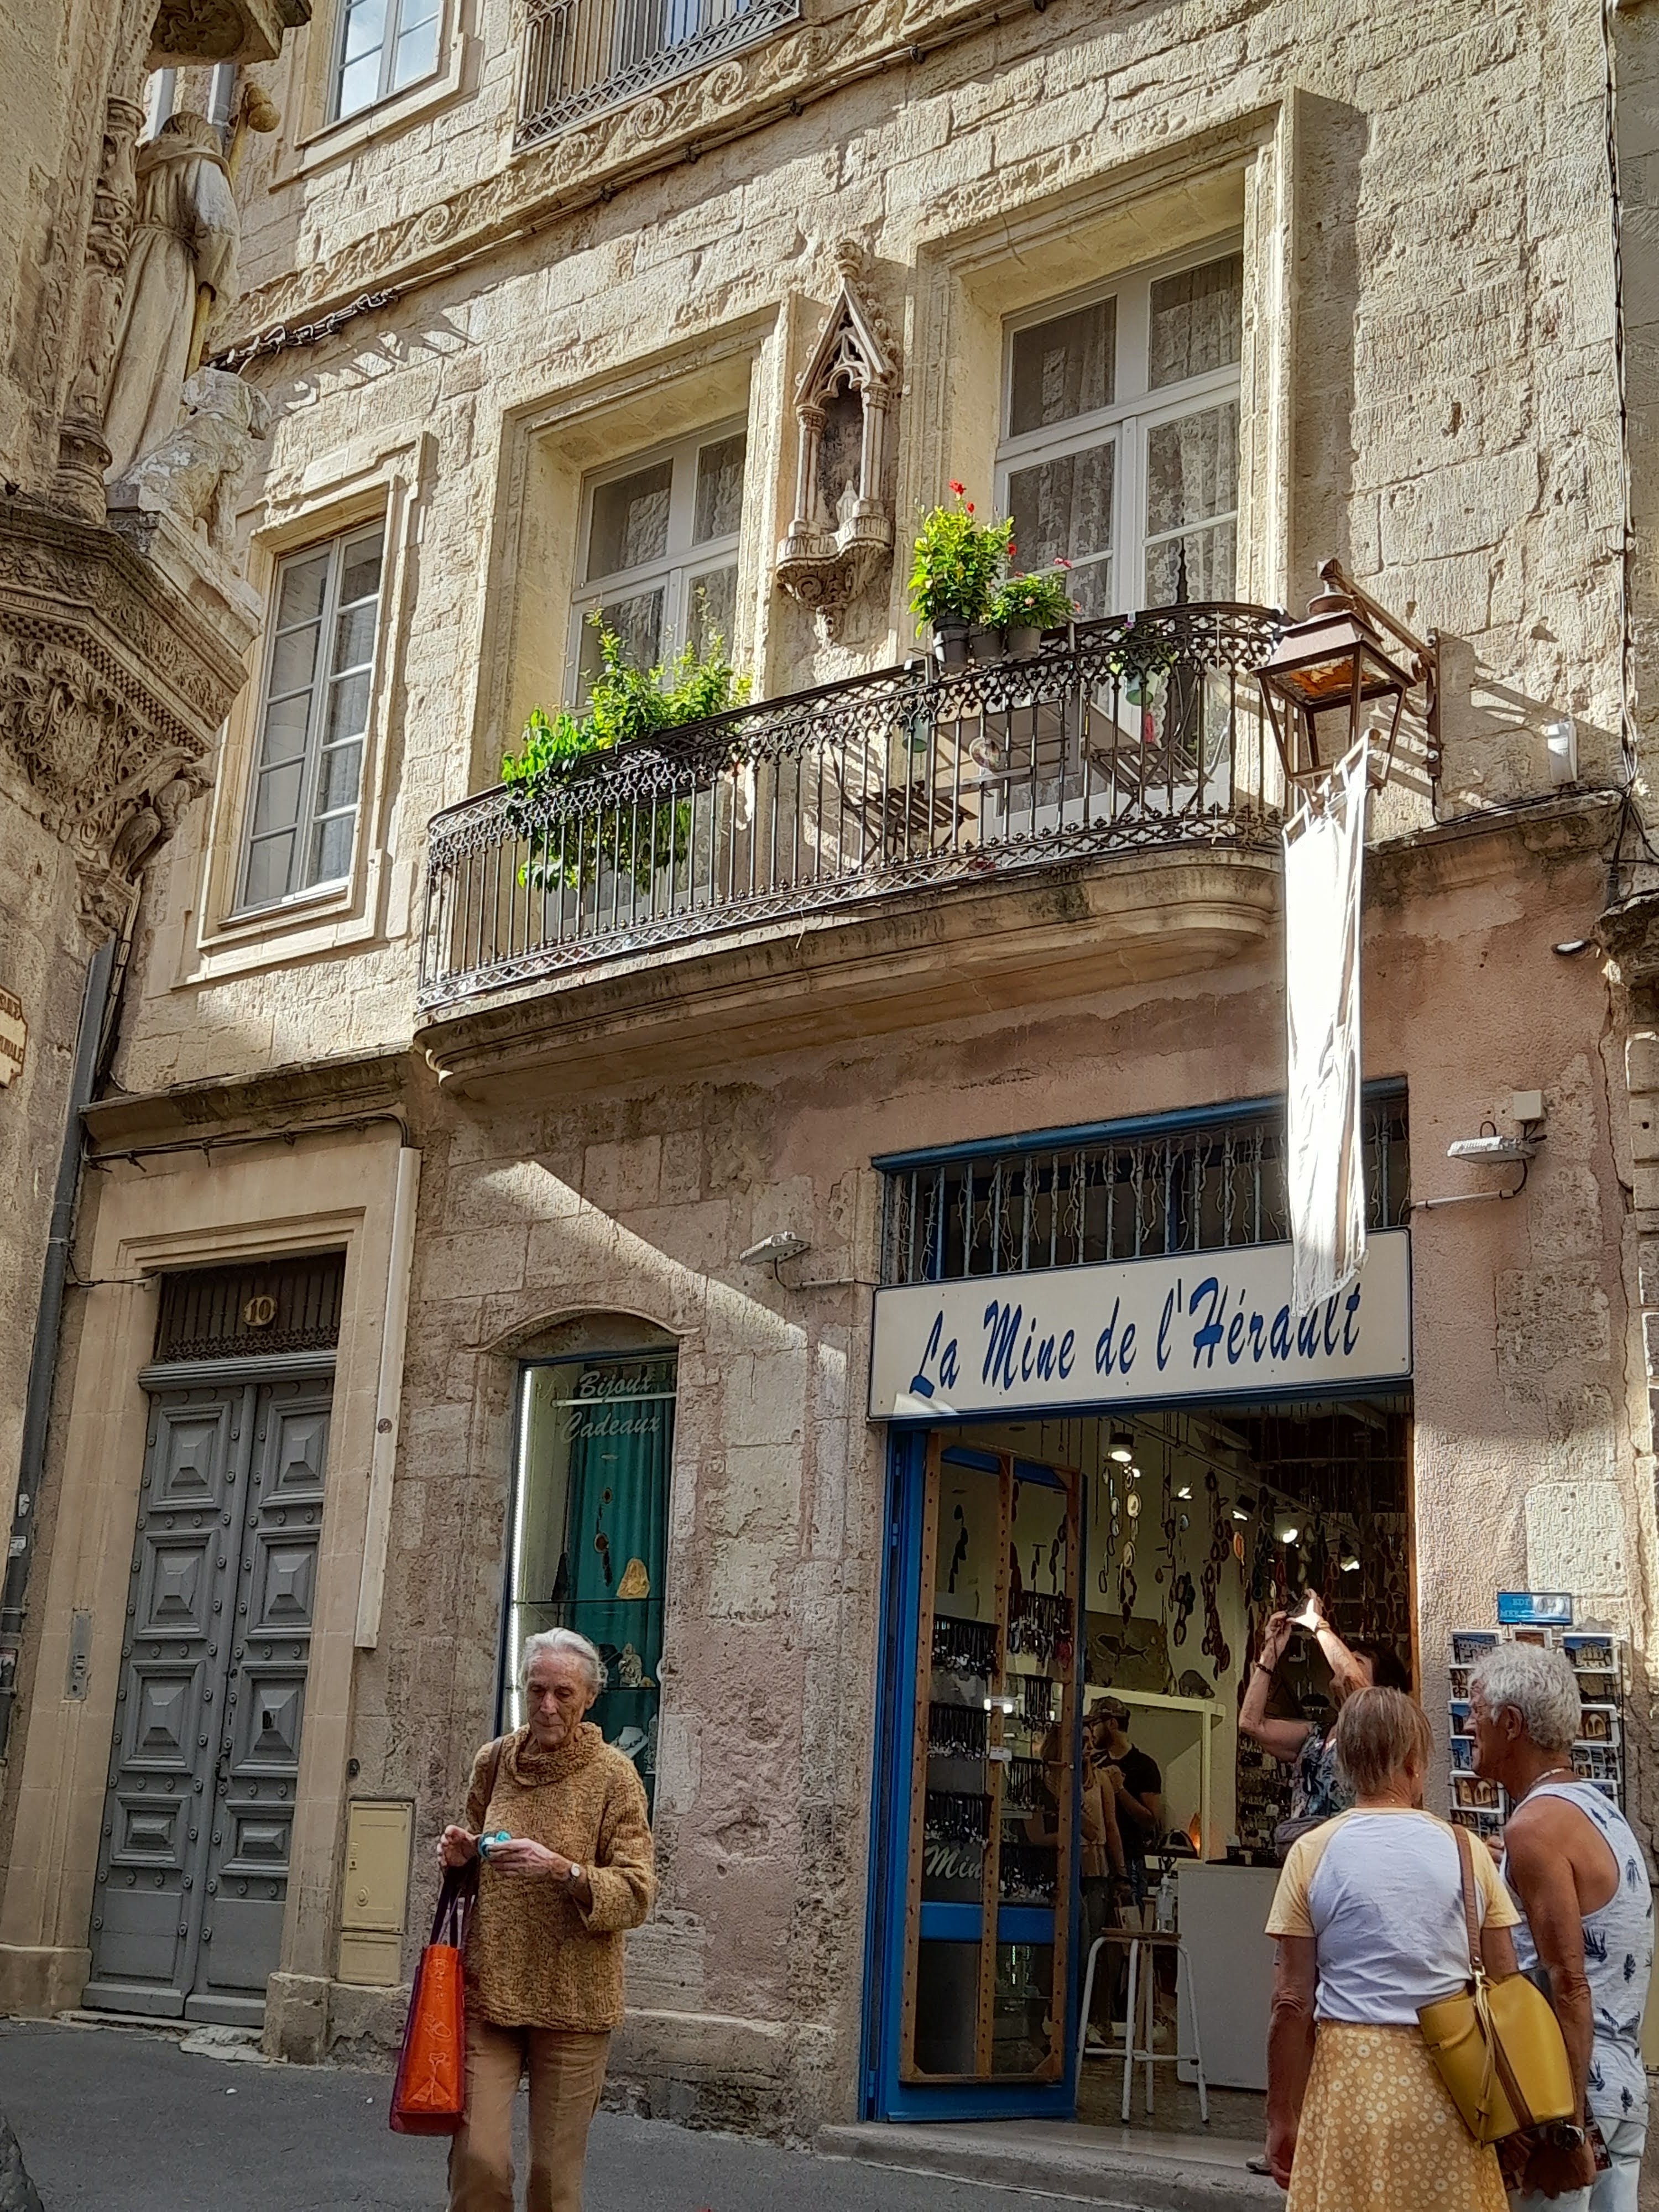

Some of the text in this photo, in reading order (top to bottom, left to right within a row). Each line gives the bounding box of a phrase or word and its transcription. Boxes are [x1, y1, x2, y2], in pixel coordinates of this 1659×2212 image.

[246, 1298, 274, 1324] 10
[910, 1276, 1361, 1399] La Mine de l'Hérault
[580, 1370, 653, 1402] Bijoux
[560, 1411, 661, 1444] Cadeaux
[924, 1843, 982, 1880] Min
